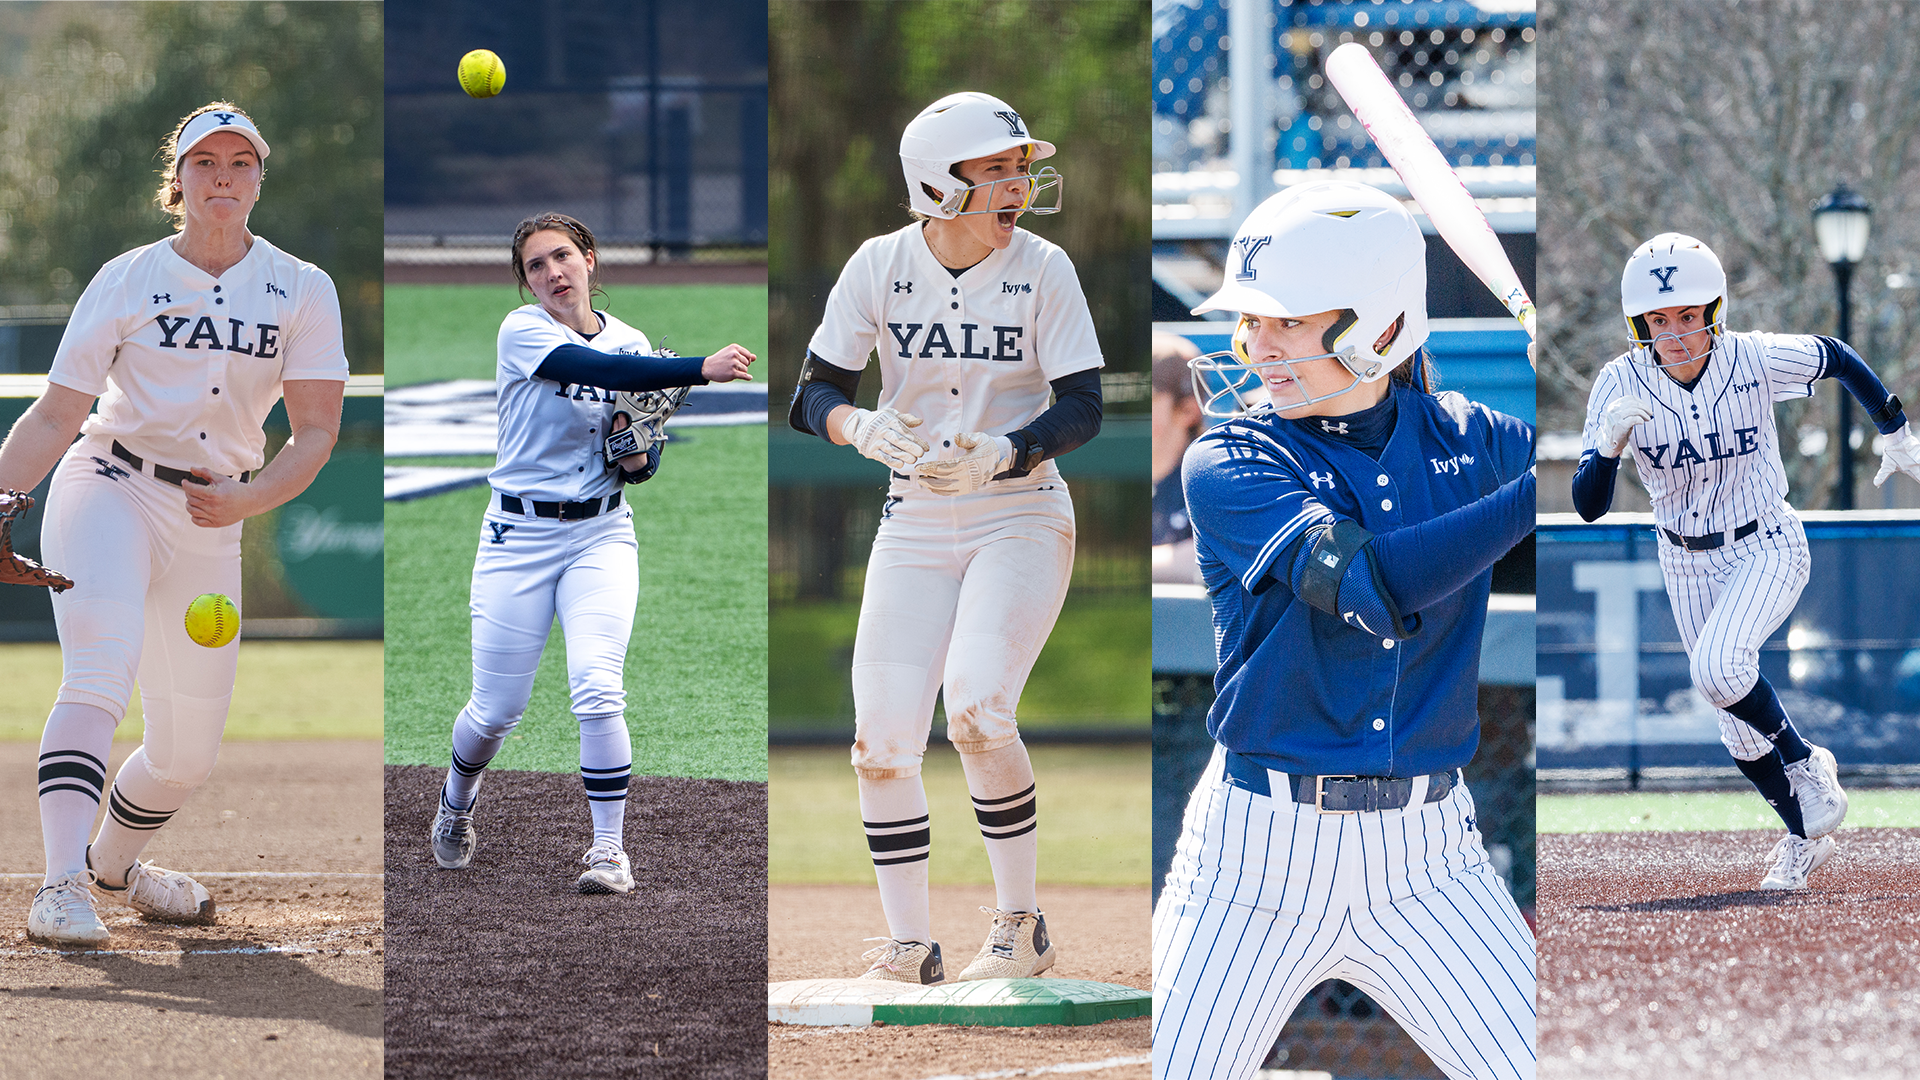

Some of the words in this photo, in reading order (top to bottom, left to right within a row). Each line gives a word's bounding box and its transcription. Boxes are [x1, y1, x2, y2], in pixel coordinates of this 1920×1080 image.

[213, 113, 235, 126] Y
[993, 110, 1025, 138] Y
[1233, 235, 1272, 282] Y
[1001, 281, 1021, 296] Ivy
[1649, 265, 1679, 294] Y
[154, 313, 280, 359] YALE
[887, 322, 1023, 361] YALE
[1732, 382, 1750, 394] Ivy
[1638, 425, 1759, 470] YALE
[1430, 456, 1460, 476] Ivy
[489, 521, 515, 545] Y
